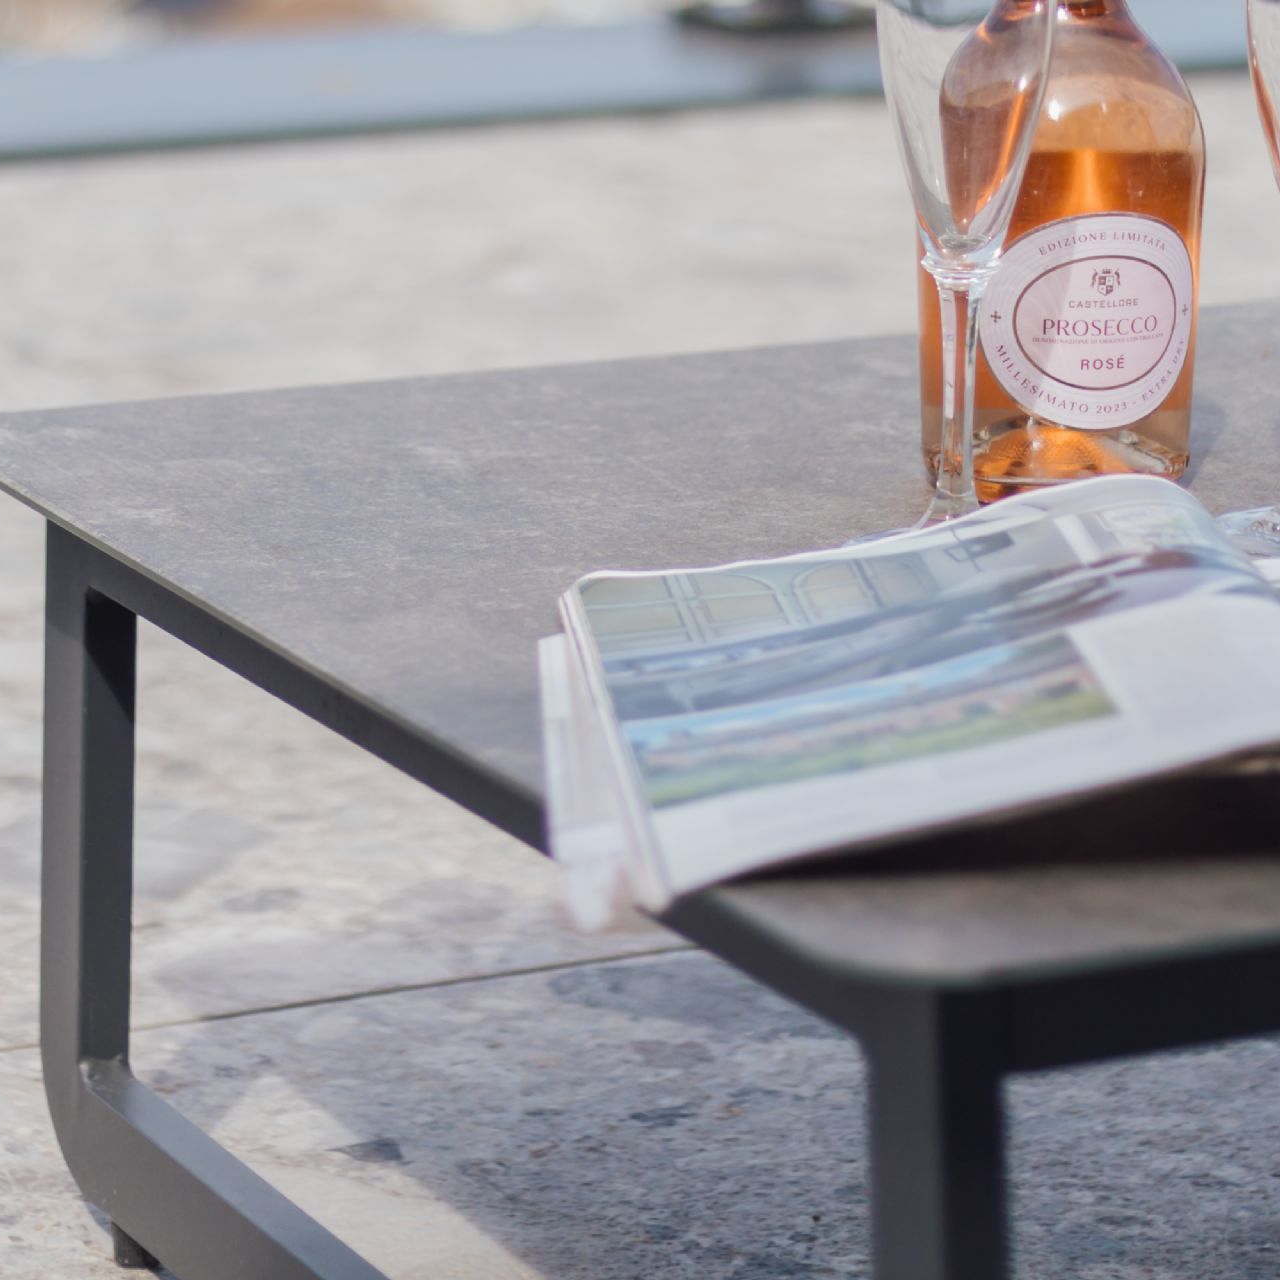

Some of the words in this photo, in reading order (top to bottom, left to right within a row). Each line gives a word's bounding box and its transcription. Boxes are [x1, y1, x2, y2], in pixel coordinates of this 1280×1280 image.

[1038, 231, 1107, 256] EDIZIONE
[1113, 231, 1167, 252] LIMITATA
[1068, 298, 1139, 309] CASTELLORE
[1042, 314, 1158, 337] PROSECCO
[1080, 354, 1126, 370] ROSÉ
[995, 344, 1090, 414] MILLESIMATO
[1096, 401, 1128, 415] 2023
[1141, 368, 1173, 401] EXTRA
